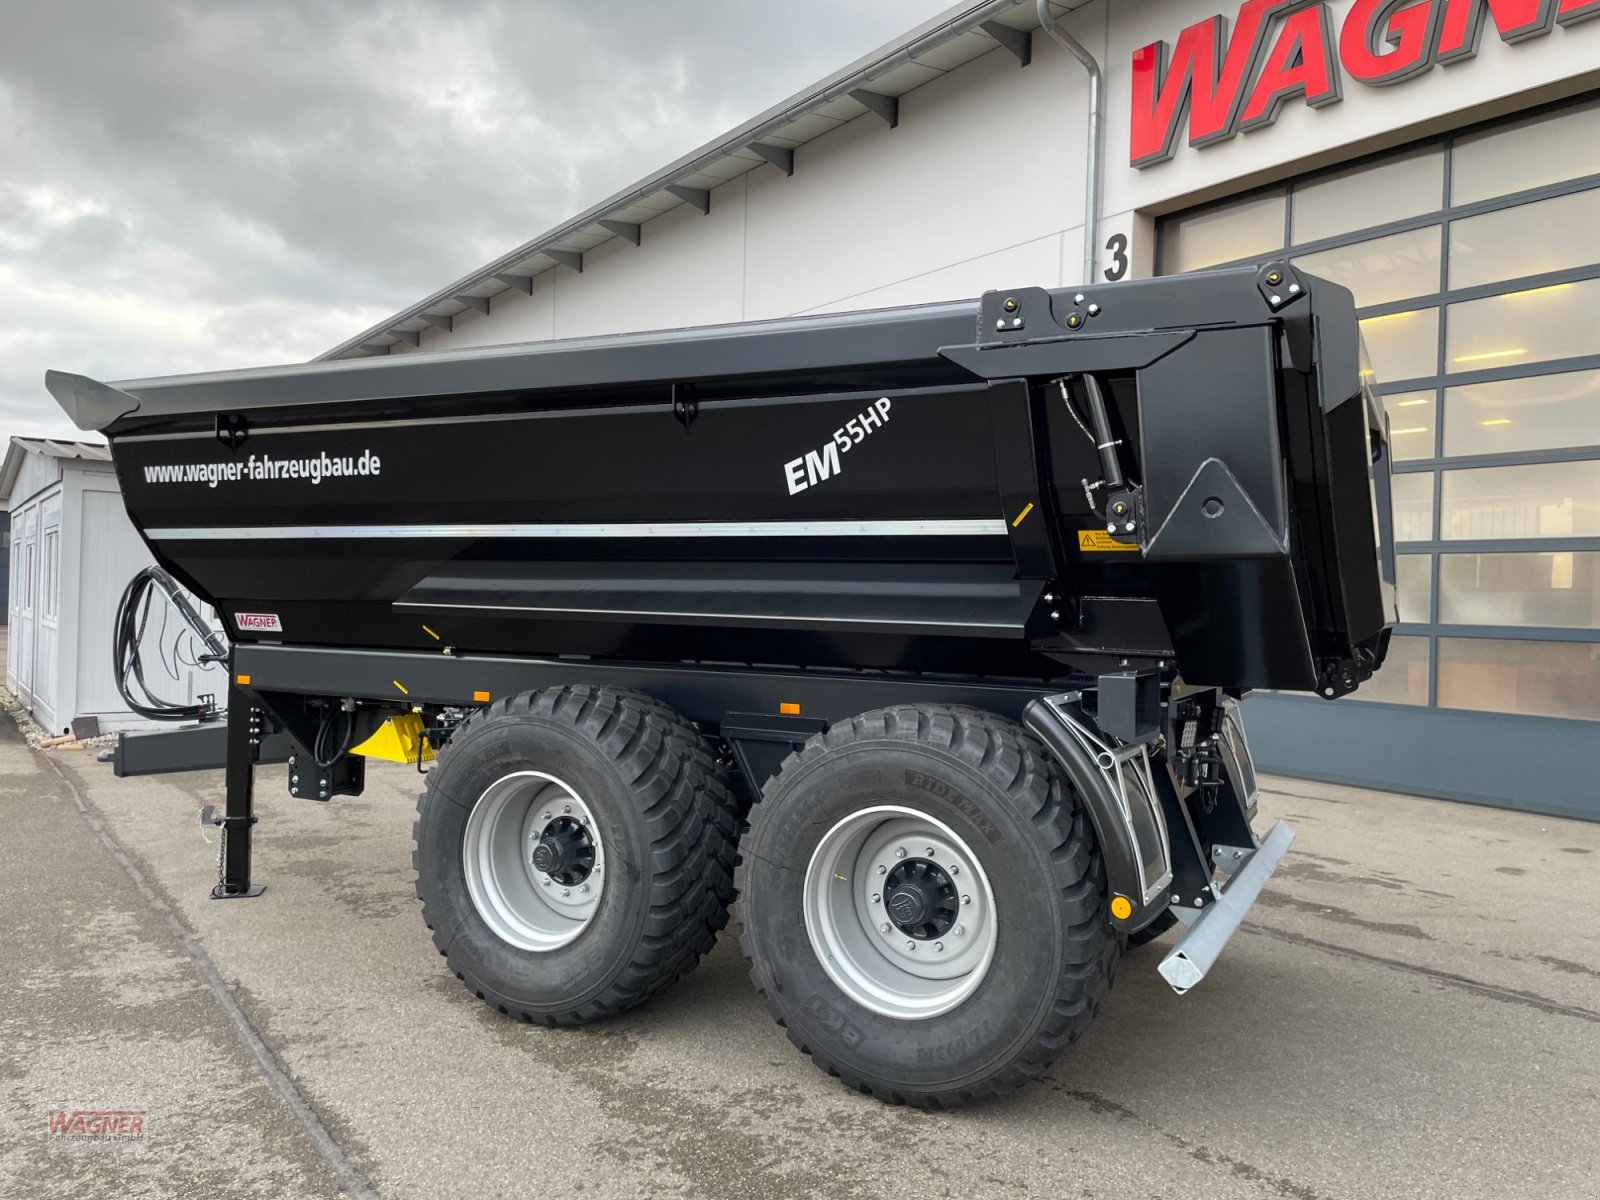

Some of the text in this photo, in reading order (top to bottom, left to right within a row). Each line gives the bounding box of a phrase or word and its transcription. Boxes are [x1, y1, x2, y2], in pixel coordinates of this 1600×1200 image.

[1104, 233, 1128, 281] 3
[144, 449, 381, 488] www.wagner-fahrzeugbau.de
[237, 614, 277, 627] WAGNER
